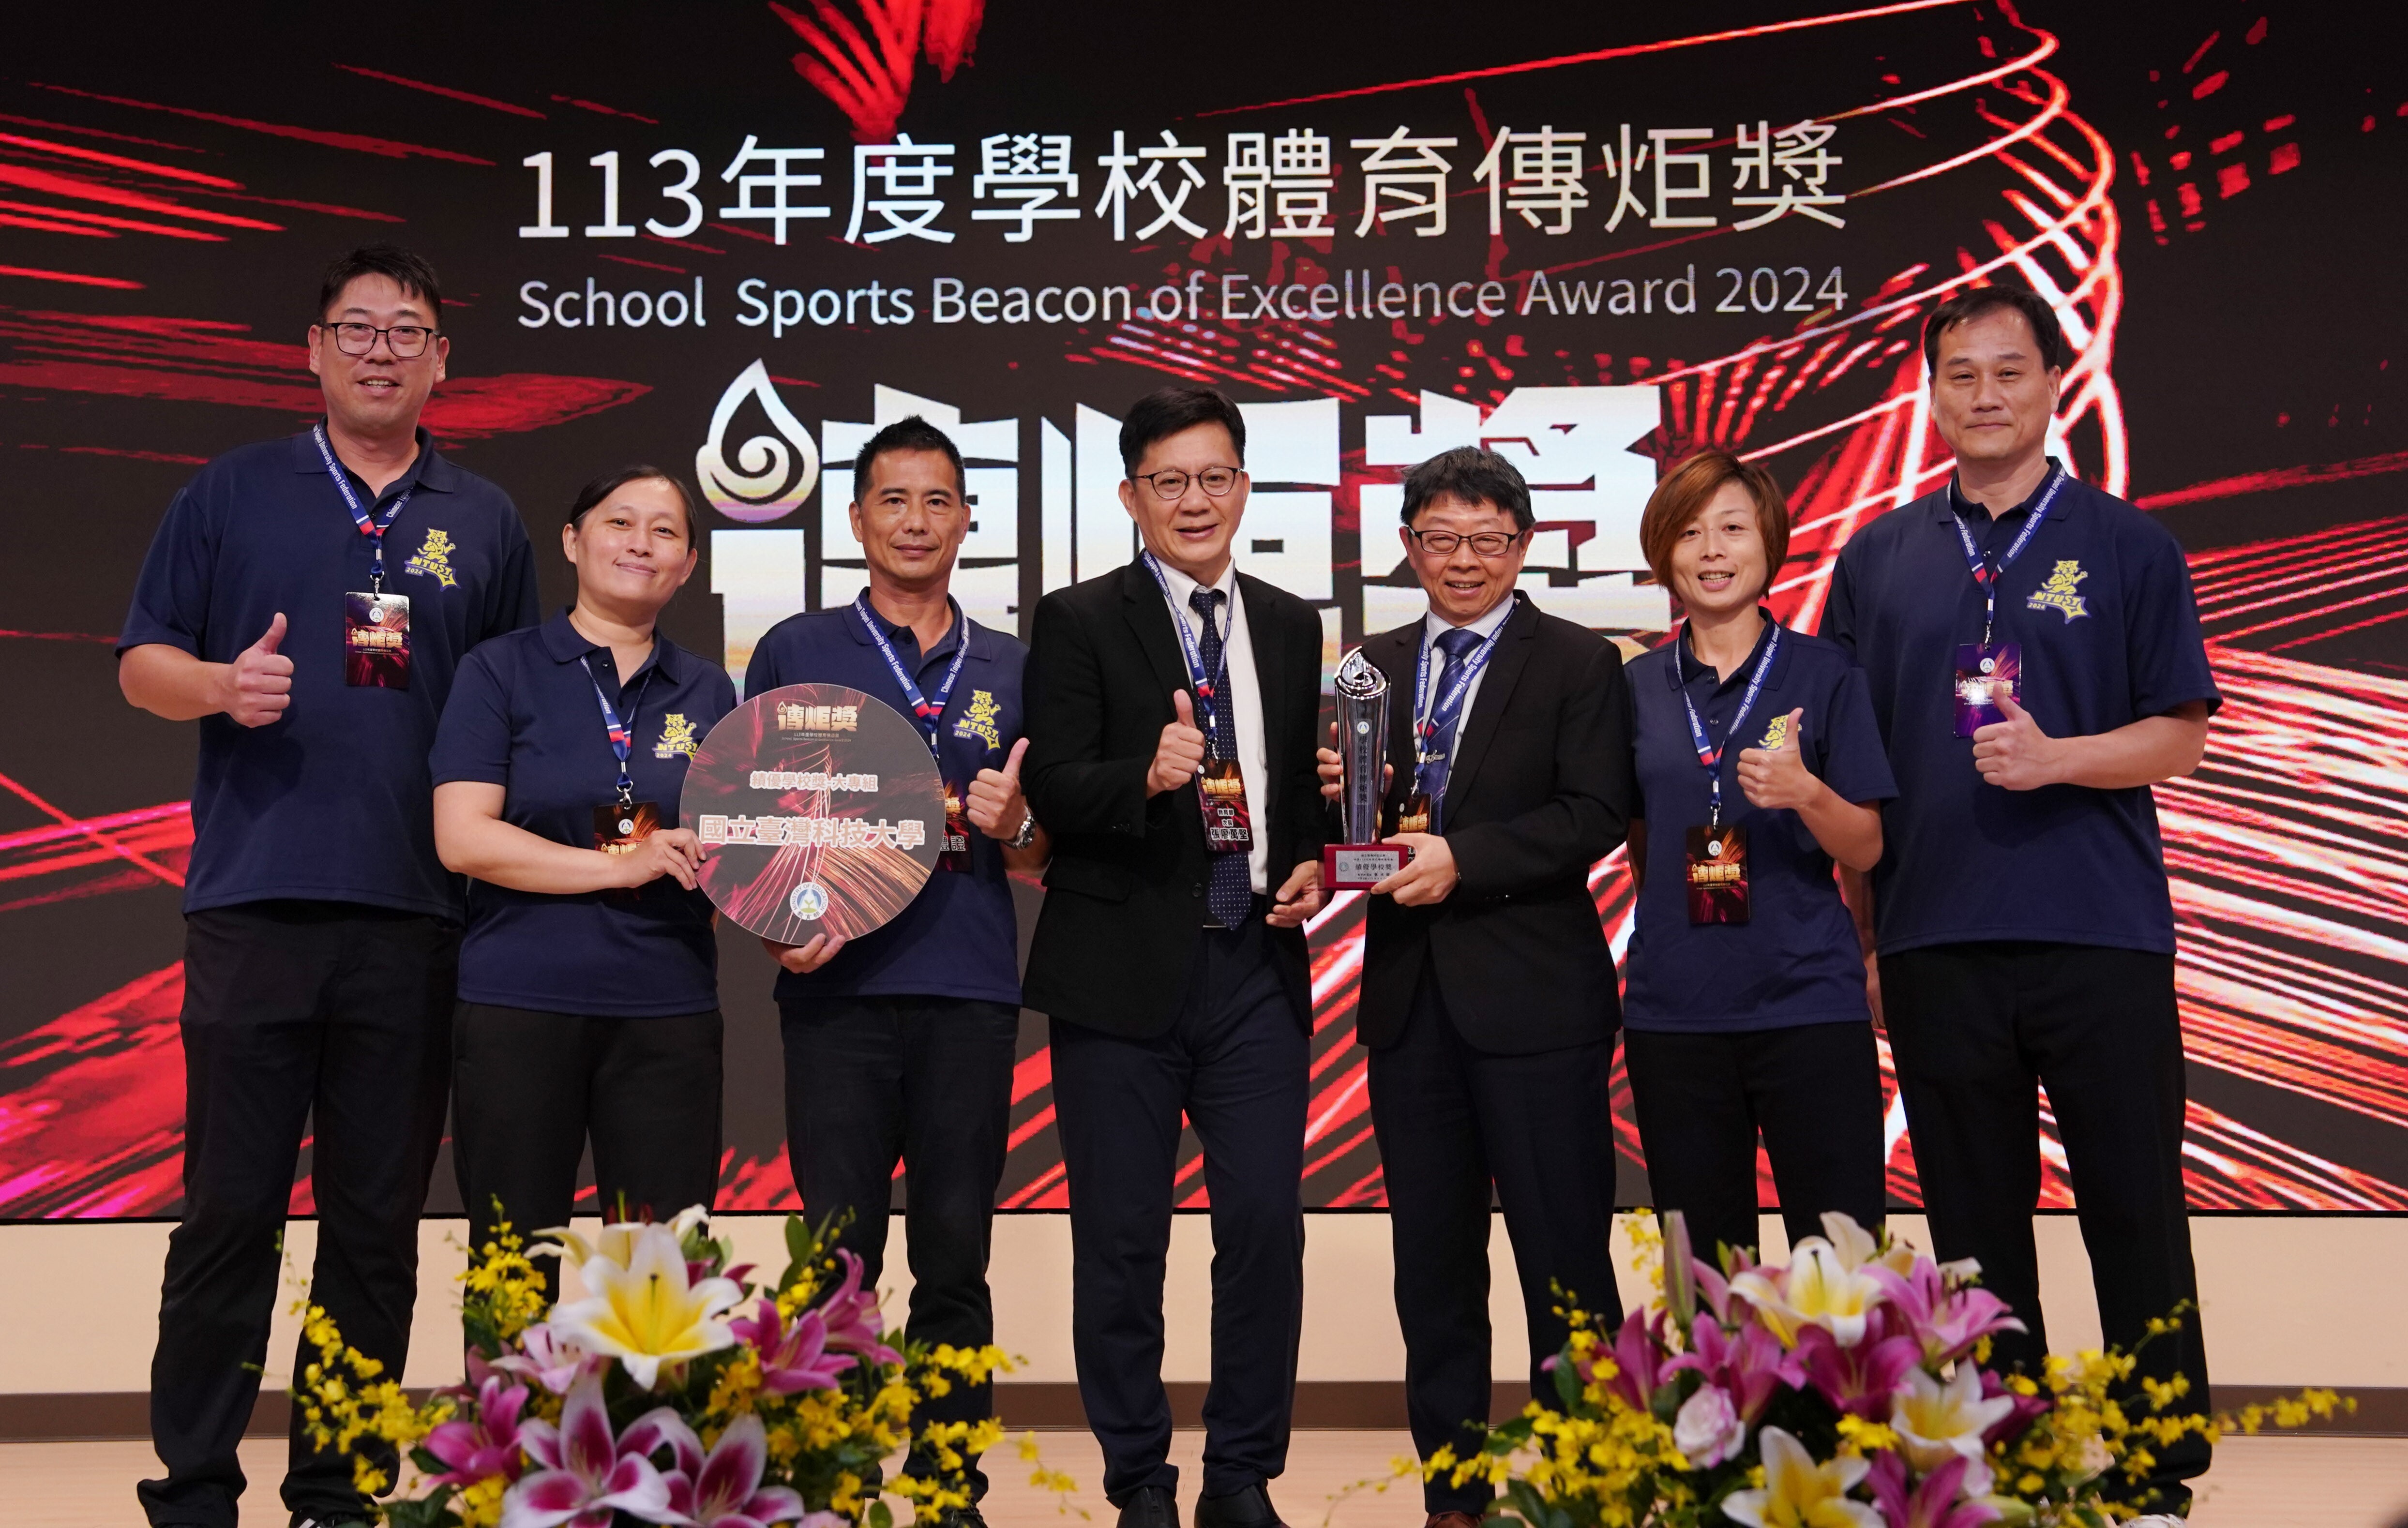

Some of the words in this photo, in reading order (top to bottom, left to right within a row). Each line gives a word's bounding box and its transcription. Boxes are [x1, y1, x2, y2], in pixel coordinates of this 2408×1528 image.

[519, 120, 1847, 245] 113年度學校體育傳炬獎
[518, 276, 706, 328] School
[736, 278, 915, 338] Sports
[933, 277, 1130, 324] Beacon
[1150, 270, 1206, 322] of
[1221, 267, 1506, 320] Excellence
[1521, 264, 1696, 317] Award
[1716, 265, 1848, 314] 2024
[329, 462, 342, 482] Sports
[338, 479, 358, 509] Federation
[386, 500, 402, 518] Chinese
[2035, 488, 2057, 513] University
[2026, 511, 2042, 530] Sports
[2007, 528, 2031, 558] Federation
[411, 556, 452, 576] NTUST
[2034, 592, 2081, 605] NTUST
[859, 608, 872, 624] Taipei
[866, 617, 886, 645] University
[881, 642, 895, 663] Sports
[891, 661, 912, 691] Federation
[1184, 632, 1200, 668] Federation
[1472, 638, 1496, 666] University
[941, 673, 956, 693] Chinese
[949, 656, 963, 673] Taipei
[1420, 660, 1429, 677] Sports
[1459, 664, 1478, 683] Sports
[1751, 654, 1773, 686] University
[1418, 678, 1427, 708] Federation
[1441, 682, 1465, 712] Federation
[1745, 683, 1758, 704] Sports
[777, 701, 858, 732] 傳炬獎
[959, 719, 999, 737] NTUST
[1729, 703, 1749, 735] Federation
[658, 741, 697, 752] NTUST
[955, 730, 971, 738] 2024
[751, 772, 877, 792] 績優學校獎-大專組
[699, 815, 925, 850] 國立臺灣科技大學
